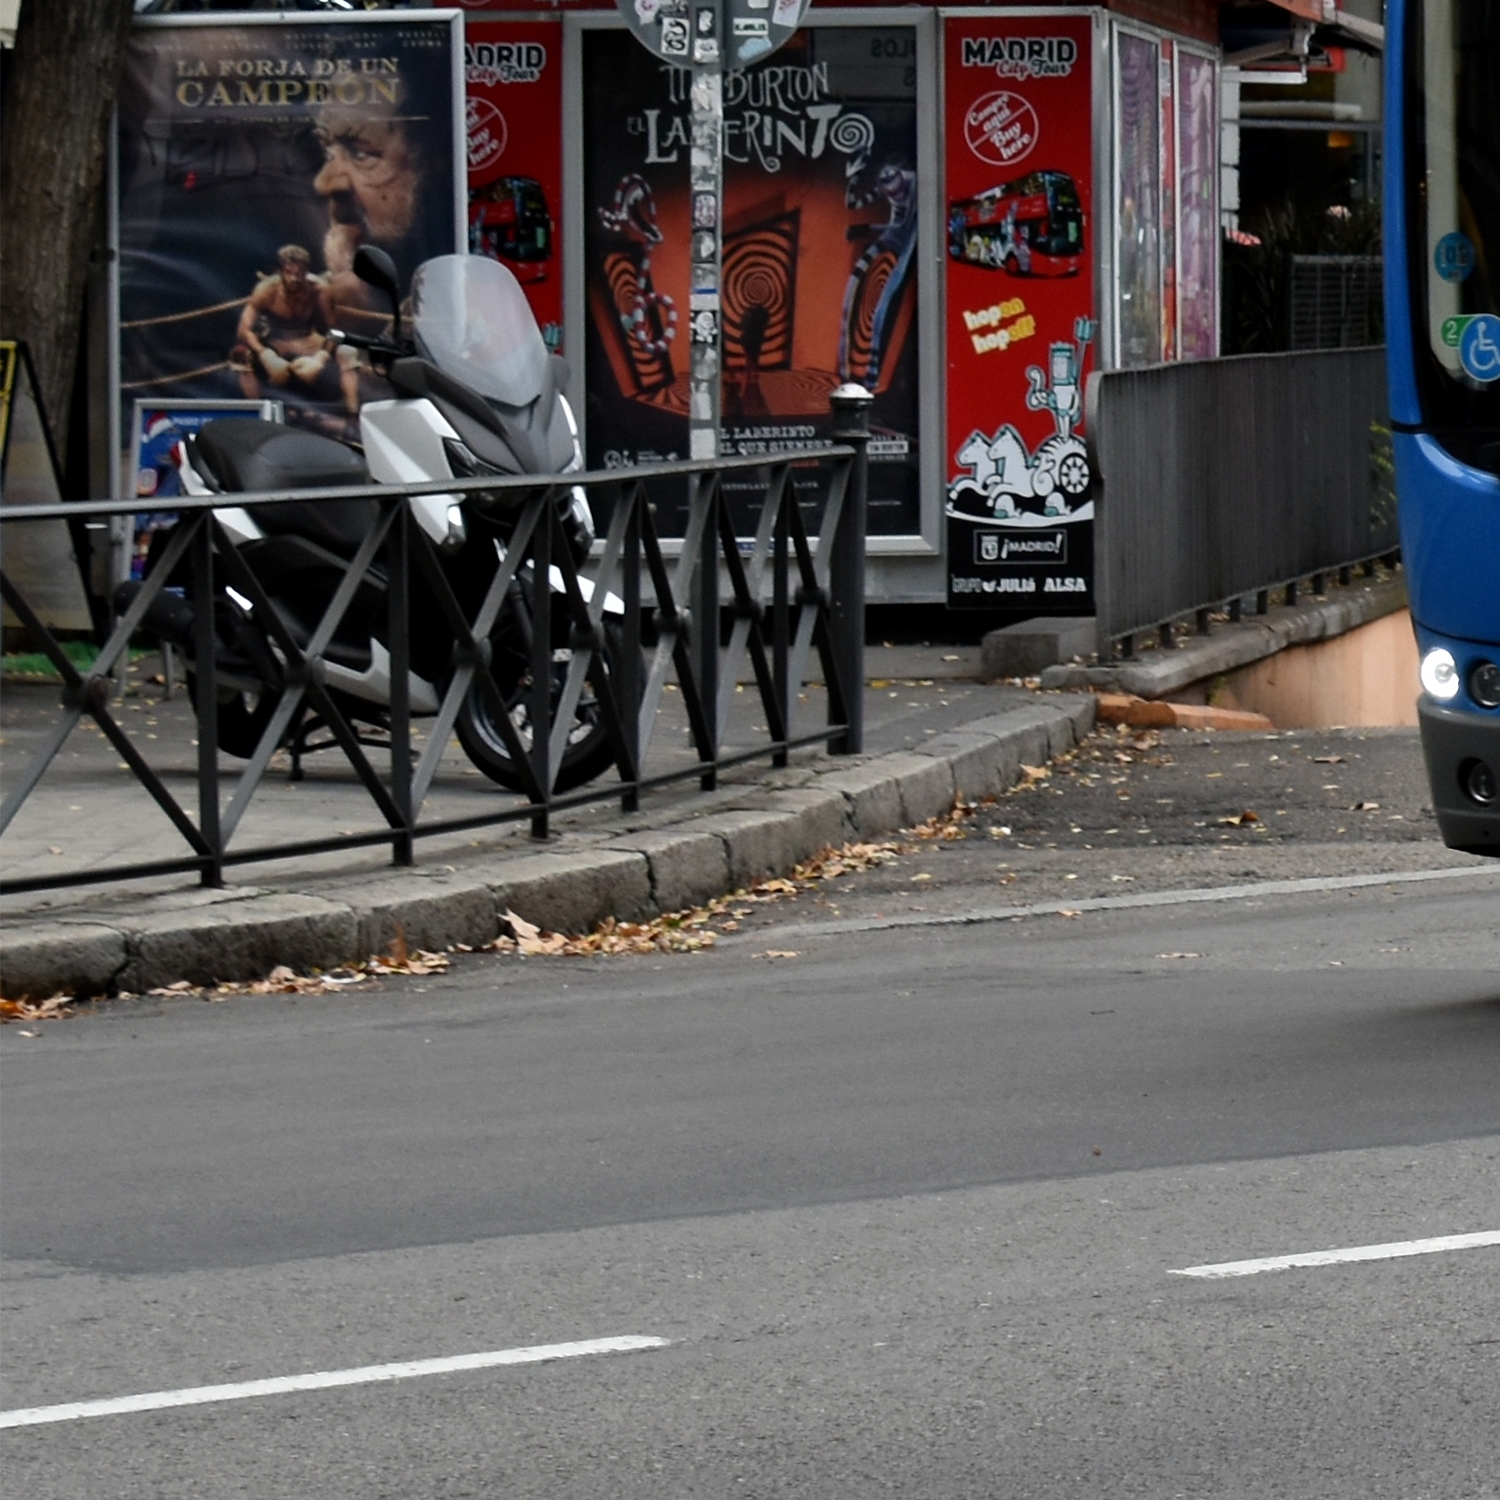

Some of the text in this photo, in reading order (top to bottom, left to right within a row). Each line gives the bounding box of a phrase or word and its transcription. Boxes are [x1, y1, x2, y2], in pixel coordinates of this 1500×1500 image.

[962, 37, 1077, 66] MADRID
[175, 58, 399, 78] LA FORJA DE UN
[174, 71, 400, 107] CAMPEÓN
[724, 62, 831, 116] BURTON
[1446, 322, 1457, 339] 2
[1043, 577, 1087, 592] ALSA
